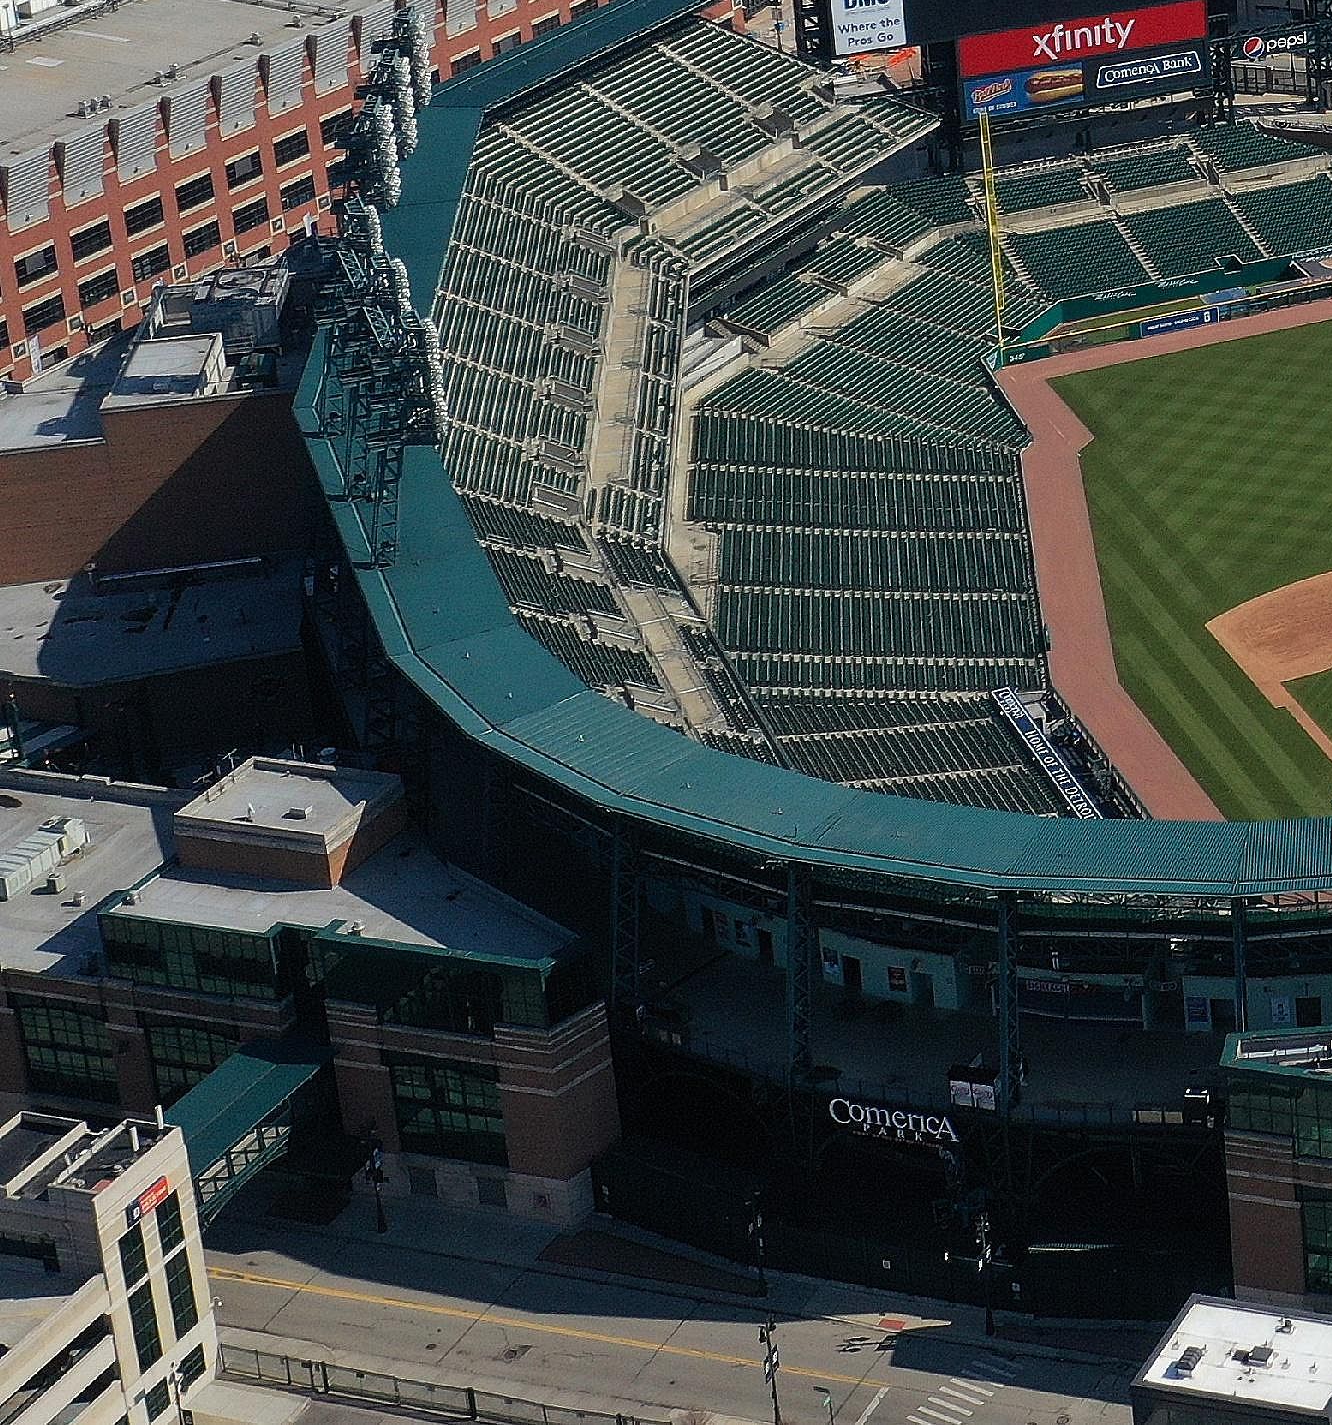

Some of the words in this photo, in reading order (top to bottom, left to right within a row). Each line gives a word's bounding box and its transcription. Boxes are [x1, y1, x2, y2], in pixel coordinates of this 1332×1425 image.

[838, 22, 877, 34] Where
[879, 17, 901, 28] the
[848, 38, 873, 47] Pros
[877, 33, 894, 42] Go
[1032, 17, 1135, 60] xfinity
[1266, 30, 1308, 53] pepsi
[1163, 55, 1192, 71] Bank
[1025, 729, 1049, 755] HOME
[1043, 756, 1059, 767] OF
[1052, 768, 1071, 785] THE
[863, 1123, 923, 1142] PARK
